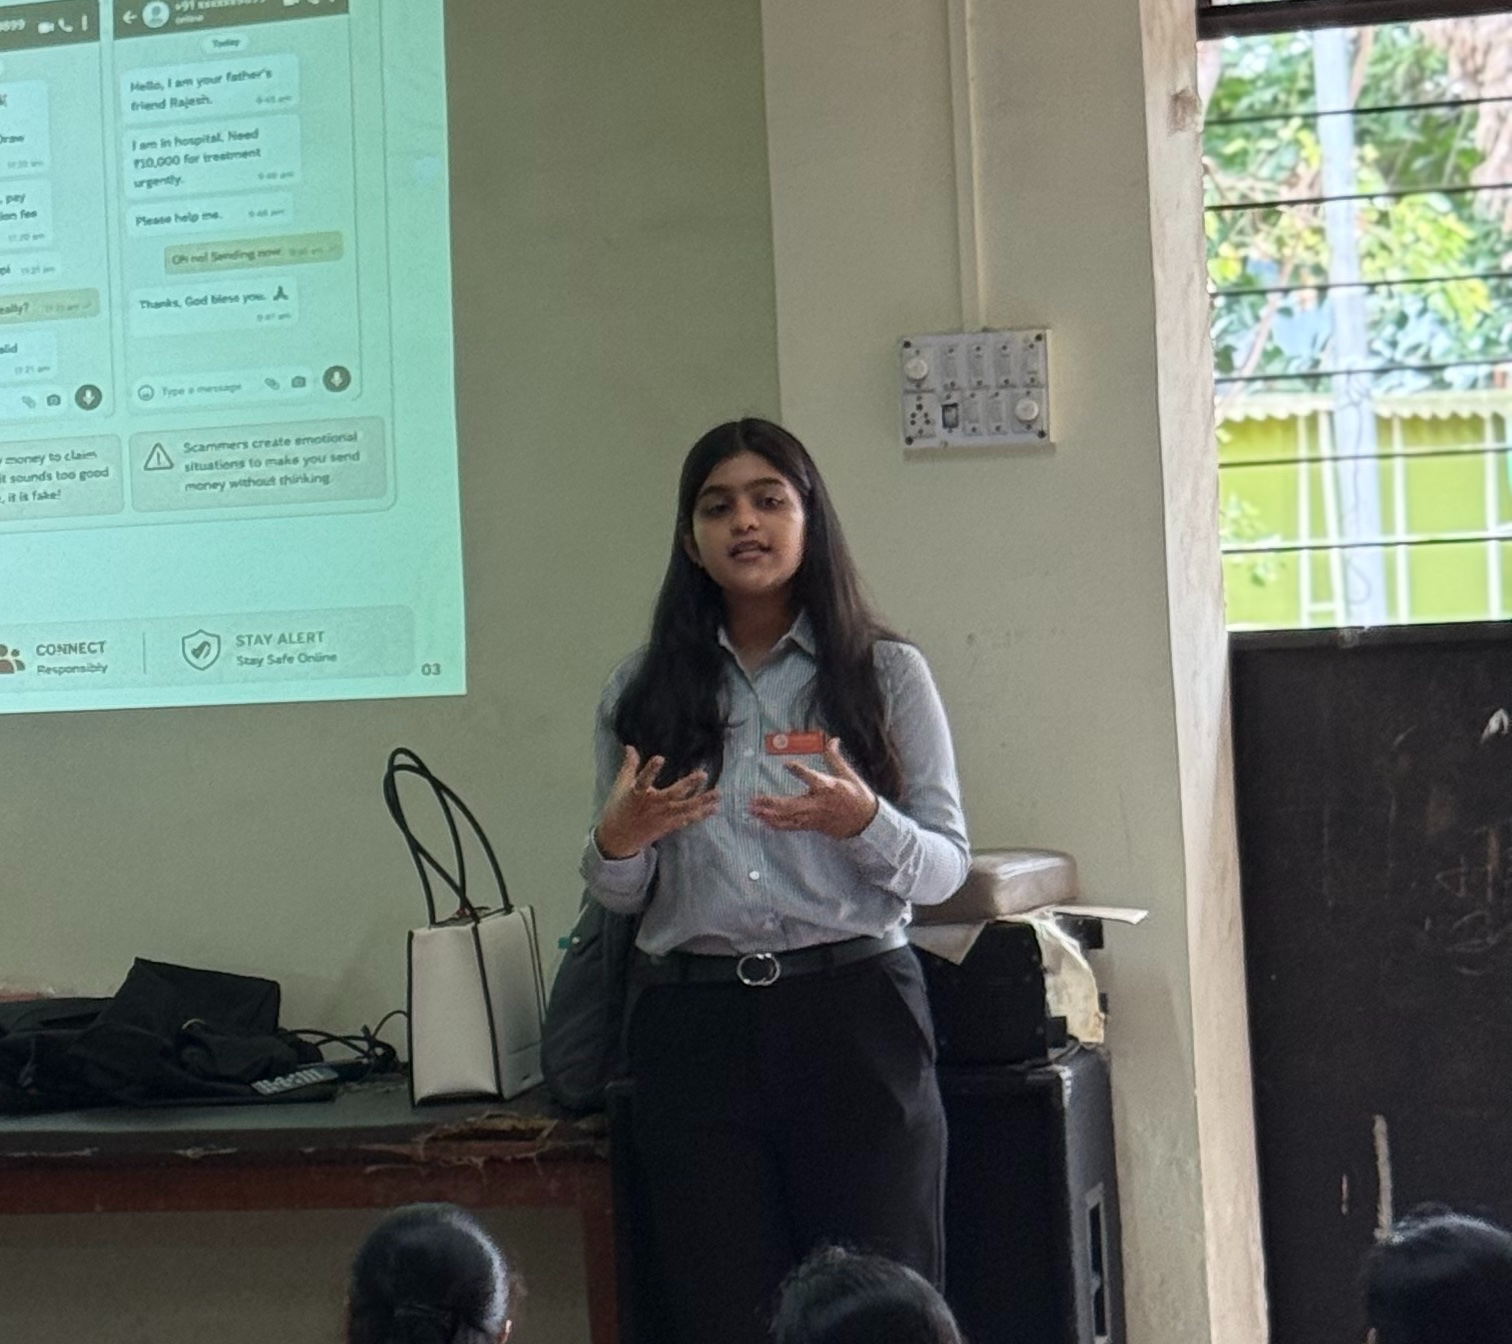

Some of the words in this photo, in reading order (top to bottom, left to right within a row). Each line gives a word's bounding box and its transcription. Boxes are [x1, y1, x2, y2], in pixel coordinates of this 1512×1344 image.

[196, 75, 223, 88] your
[228, 128, 259, 140] Need
[183, 153, 200, 164] for
[184, 441, 248, 453] Scammers
[252, 437, 291, 449] create
[294, 430, 358, 446] emotional
[5, 455, 46, 465] money
[49, 453, 61, 462] to
[64, 450, 97, 460] claim
[184, 460, 245, 473] situations
[249, 458, 262, 468] to
[265, 456, 299, 467] make
[303, 455, 327, 468] you
[330, 451, 360, 463] send
[10, 473, 52, 483] sounds
[56, 471, 76, 480] too
[79, 467, 109, 480] good
[185, 479, 226, 491] money
[229, 476, 276, 489] without
[8, 493, 16, 502] it
[19, 493, 29, 501] is
[32, 489, 61, 501] fake!
[235, 634, 273, 647] STAY
[277, 631, 325, 645] ALERT
[36, 640, 107, 657] CONNECT
[236, 656, 264, 667] Stay
[267, 653, 295, 665] Safe
[298, 652, 337, 662] Online
[37, 663, 108, 676] Responsibly
[421, 663, 441, 676] 03
